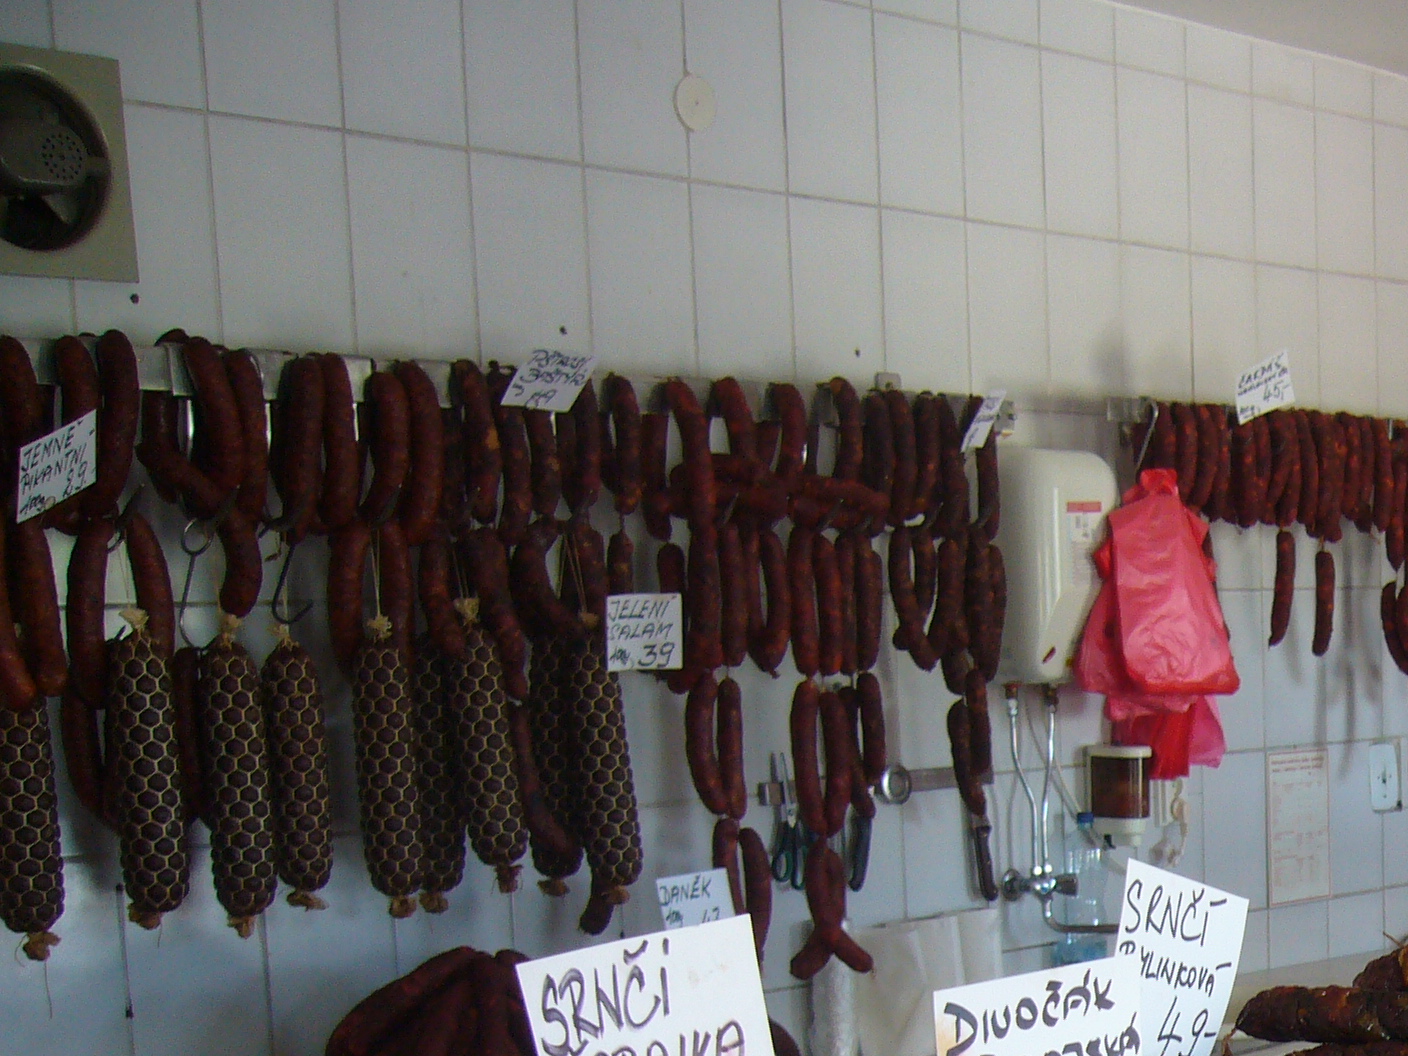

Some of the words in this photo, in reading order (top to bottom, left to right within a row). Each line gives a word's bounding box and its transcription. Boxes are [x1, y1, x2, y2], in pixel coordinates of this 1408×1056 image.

[607, 594, 678, 622] JELENÍ
[637, 641, 676, 669] 39
[659, 873, 712, 907] DANĚK
[1126, 876, 1228, 946] SRNČÍ
